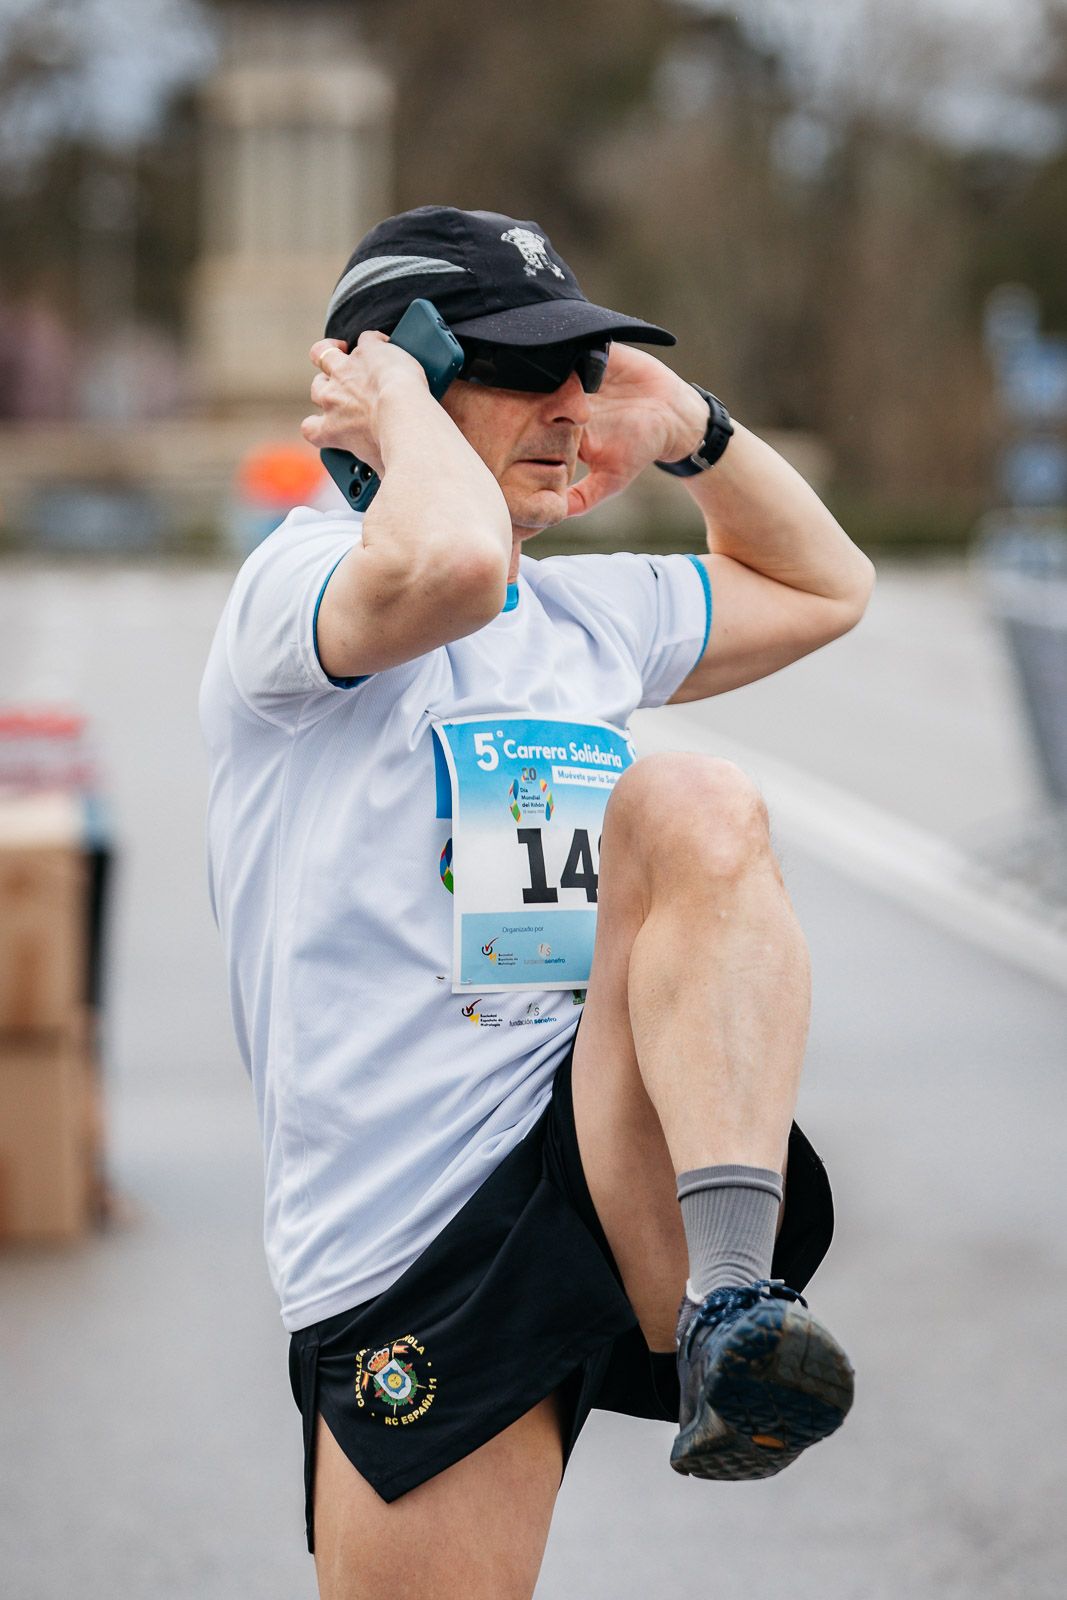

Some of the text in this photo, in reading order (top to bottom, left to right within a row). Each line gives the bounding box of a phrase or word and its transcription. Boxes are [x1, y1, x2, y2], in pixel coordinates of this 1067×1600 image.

[503, 739, 567, 761] Carrera
[569, 742, 622, 767] Solidaria
[517, 828, 602, 904] 14
[502, 926, 534, 934] Organizado
[385, 1377, 437, 1426] RC ESPAÑA 11
